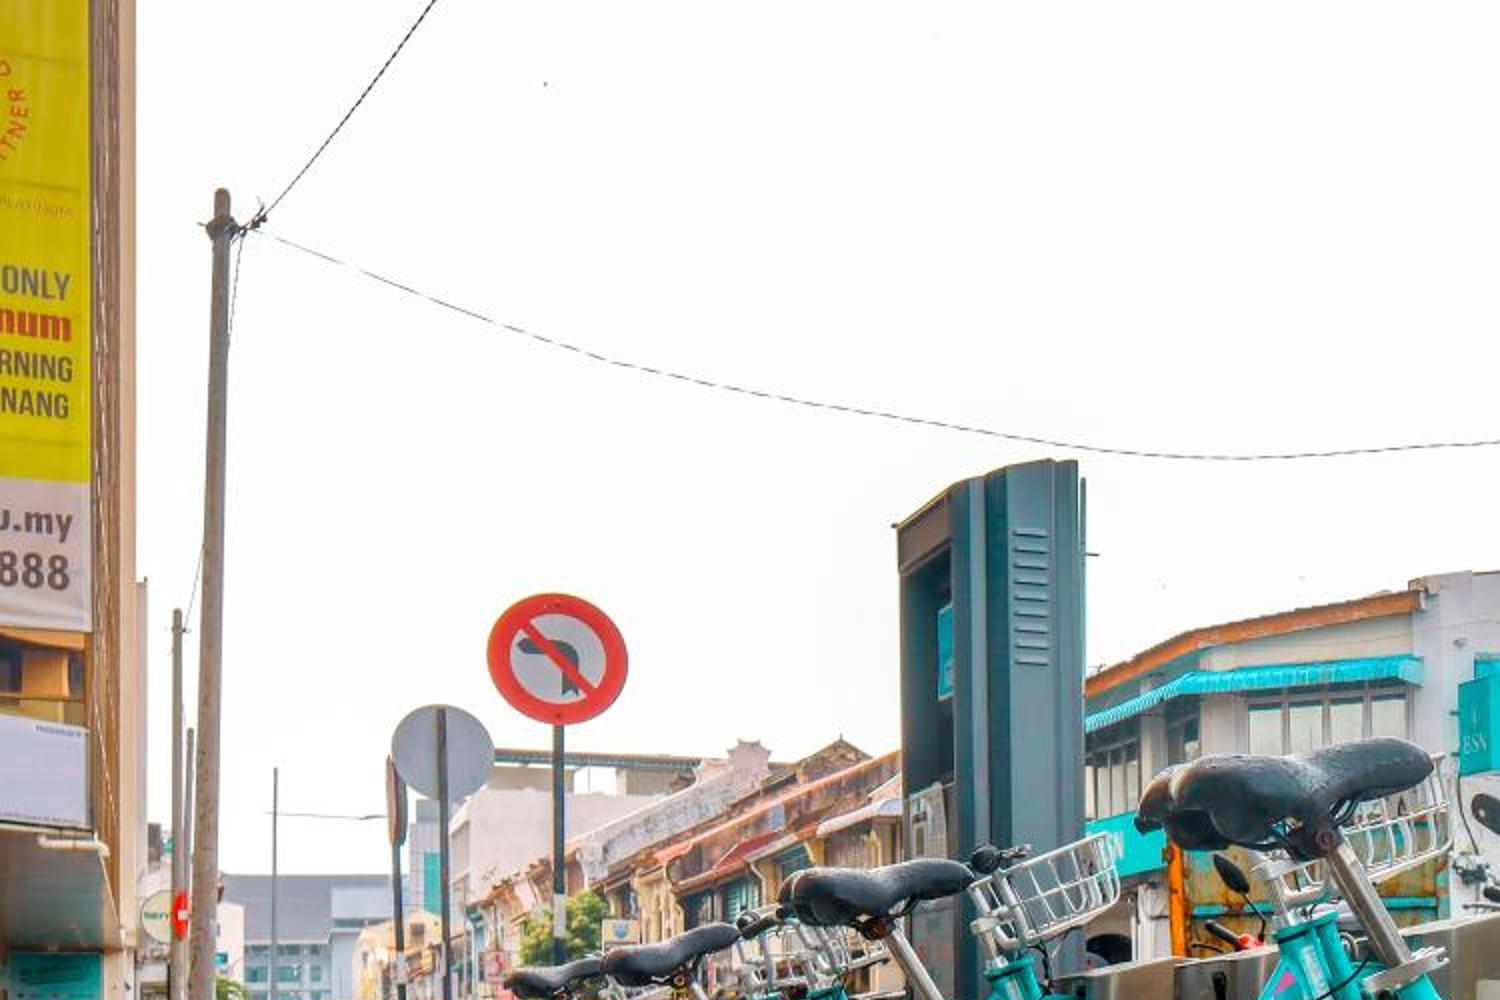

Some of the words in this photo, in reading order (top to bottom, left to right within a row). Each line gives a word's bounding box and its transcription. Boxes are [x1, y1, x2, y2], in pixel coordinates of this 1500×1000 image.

[2, 264, 71, 301] ONLY
[0, 349, 73, 383] RNING
[1, 386, 70, 419] NANG
[0, 550, 70, 591] 888
